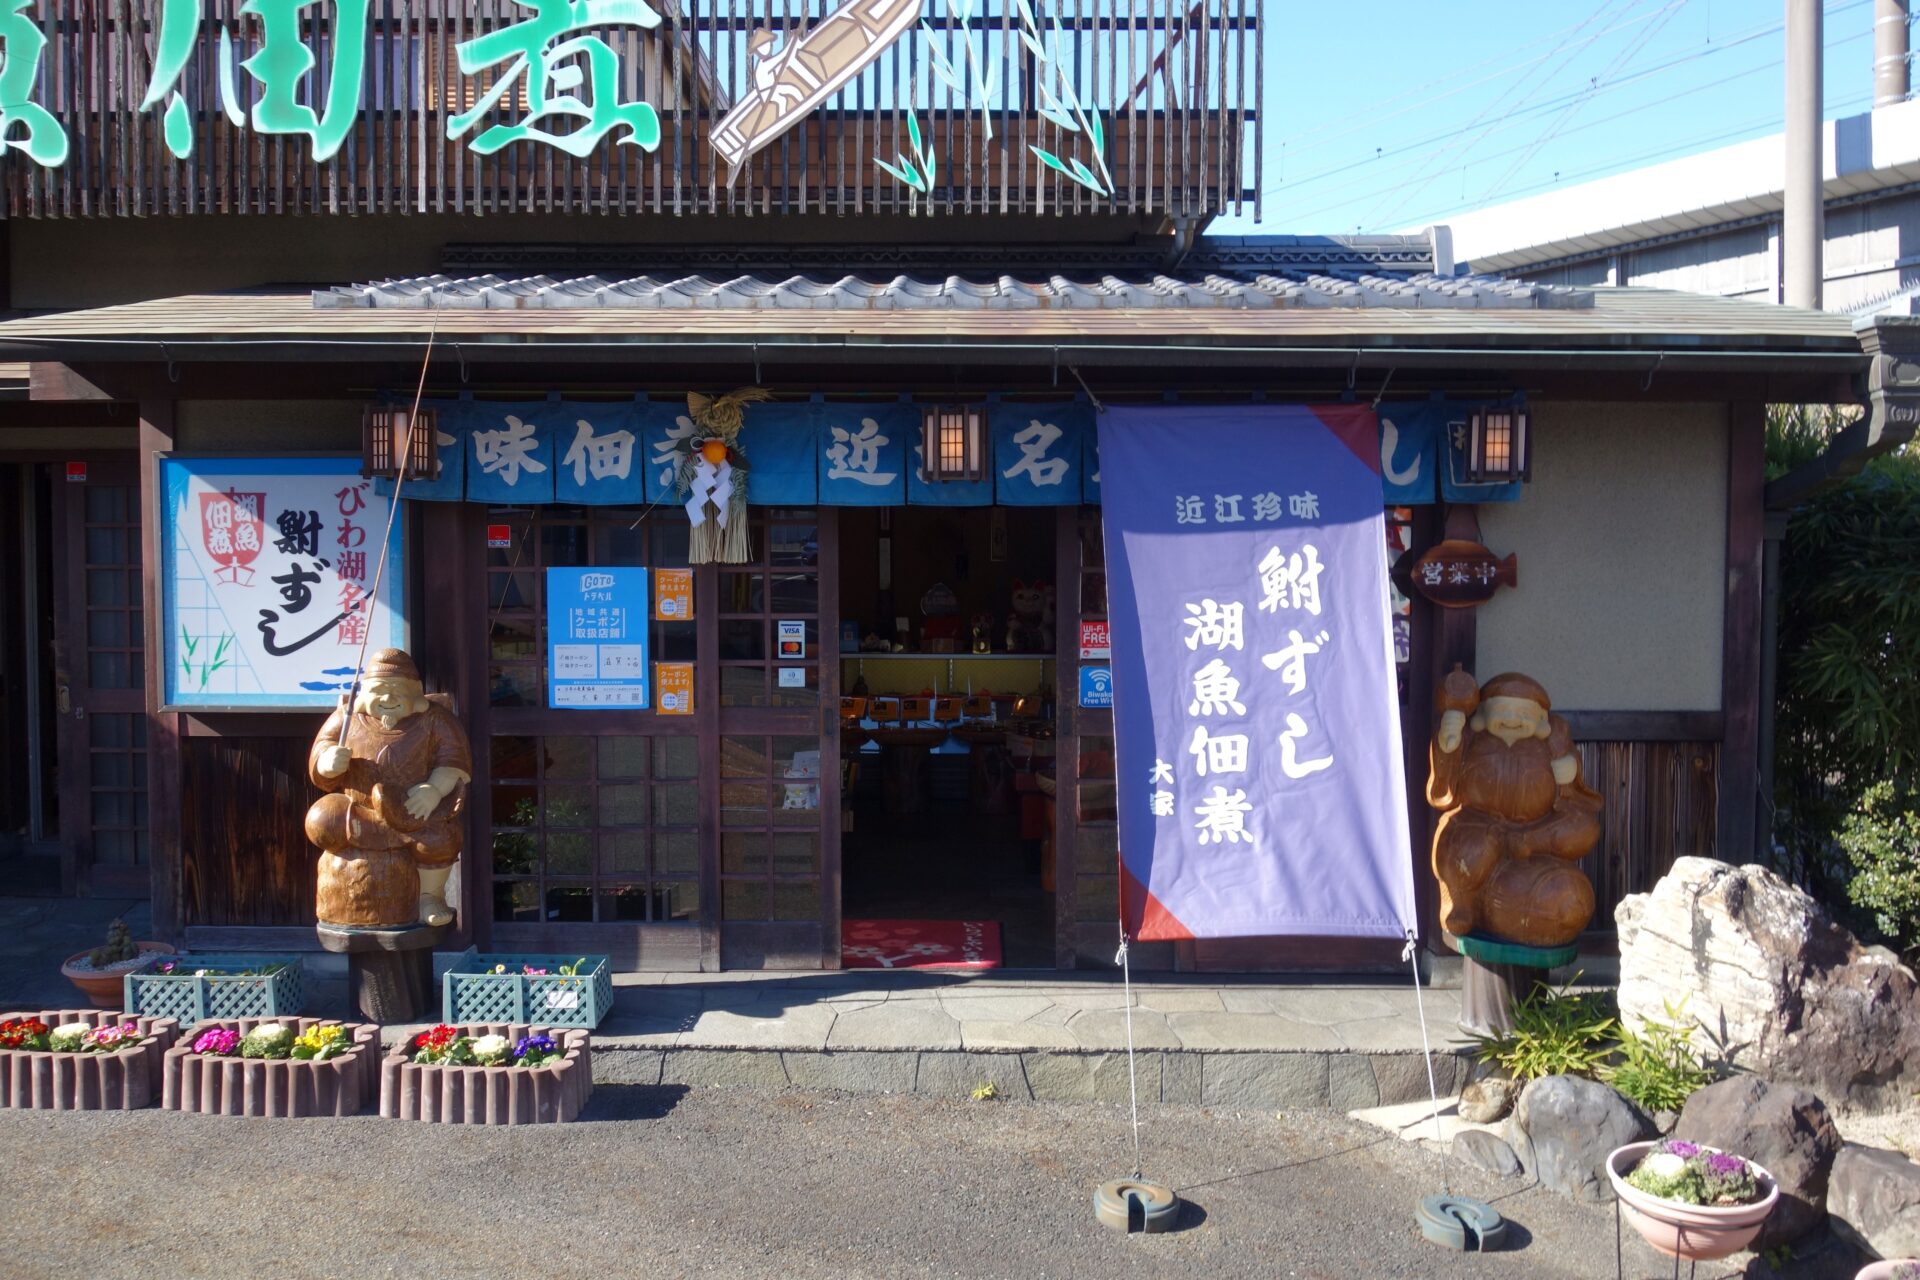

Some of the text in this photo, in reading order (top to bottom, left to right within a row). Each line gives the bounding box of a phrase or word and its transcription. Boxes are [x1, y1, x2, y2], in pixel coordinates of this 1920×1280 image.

[1176, 491, 1321, 524] 近江珍味
[334, 482, 370, 647] びわ湖名産
[1421, 561, 1496, 585] 営業中
[258, 509, 374, 657] 鮒ずし
[584, 592, 612, 601] トラベル
[575, 617, 620, 627] クーポン
[575, 628, 620, 639] 取扱店舗
[1257, 544, 1334, 779] 鮒ずし
[1183, 598, 1254, 846] 湖魚佃煮
